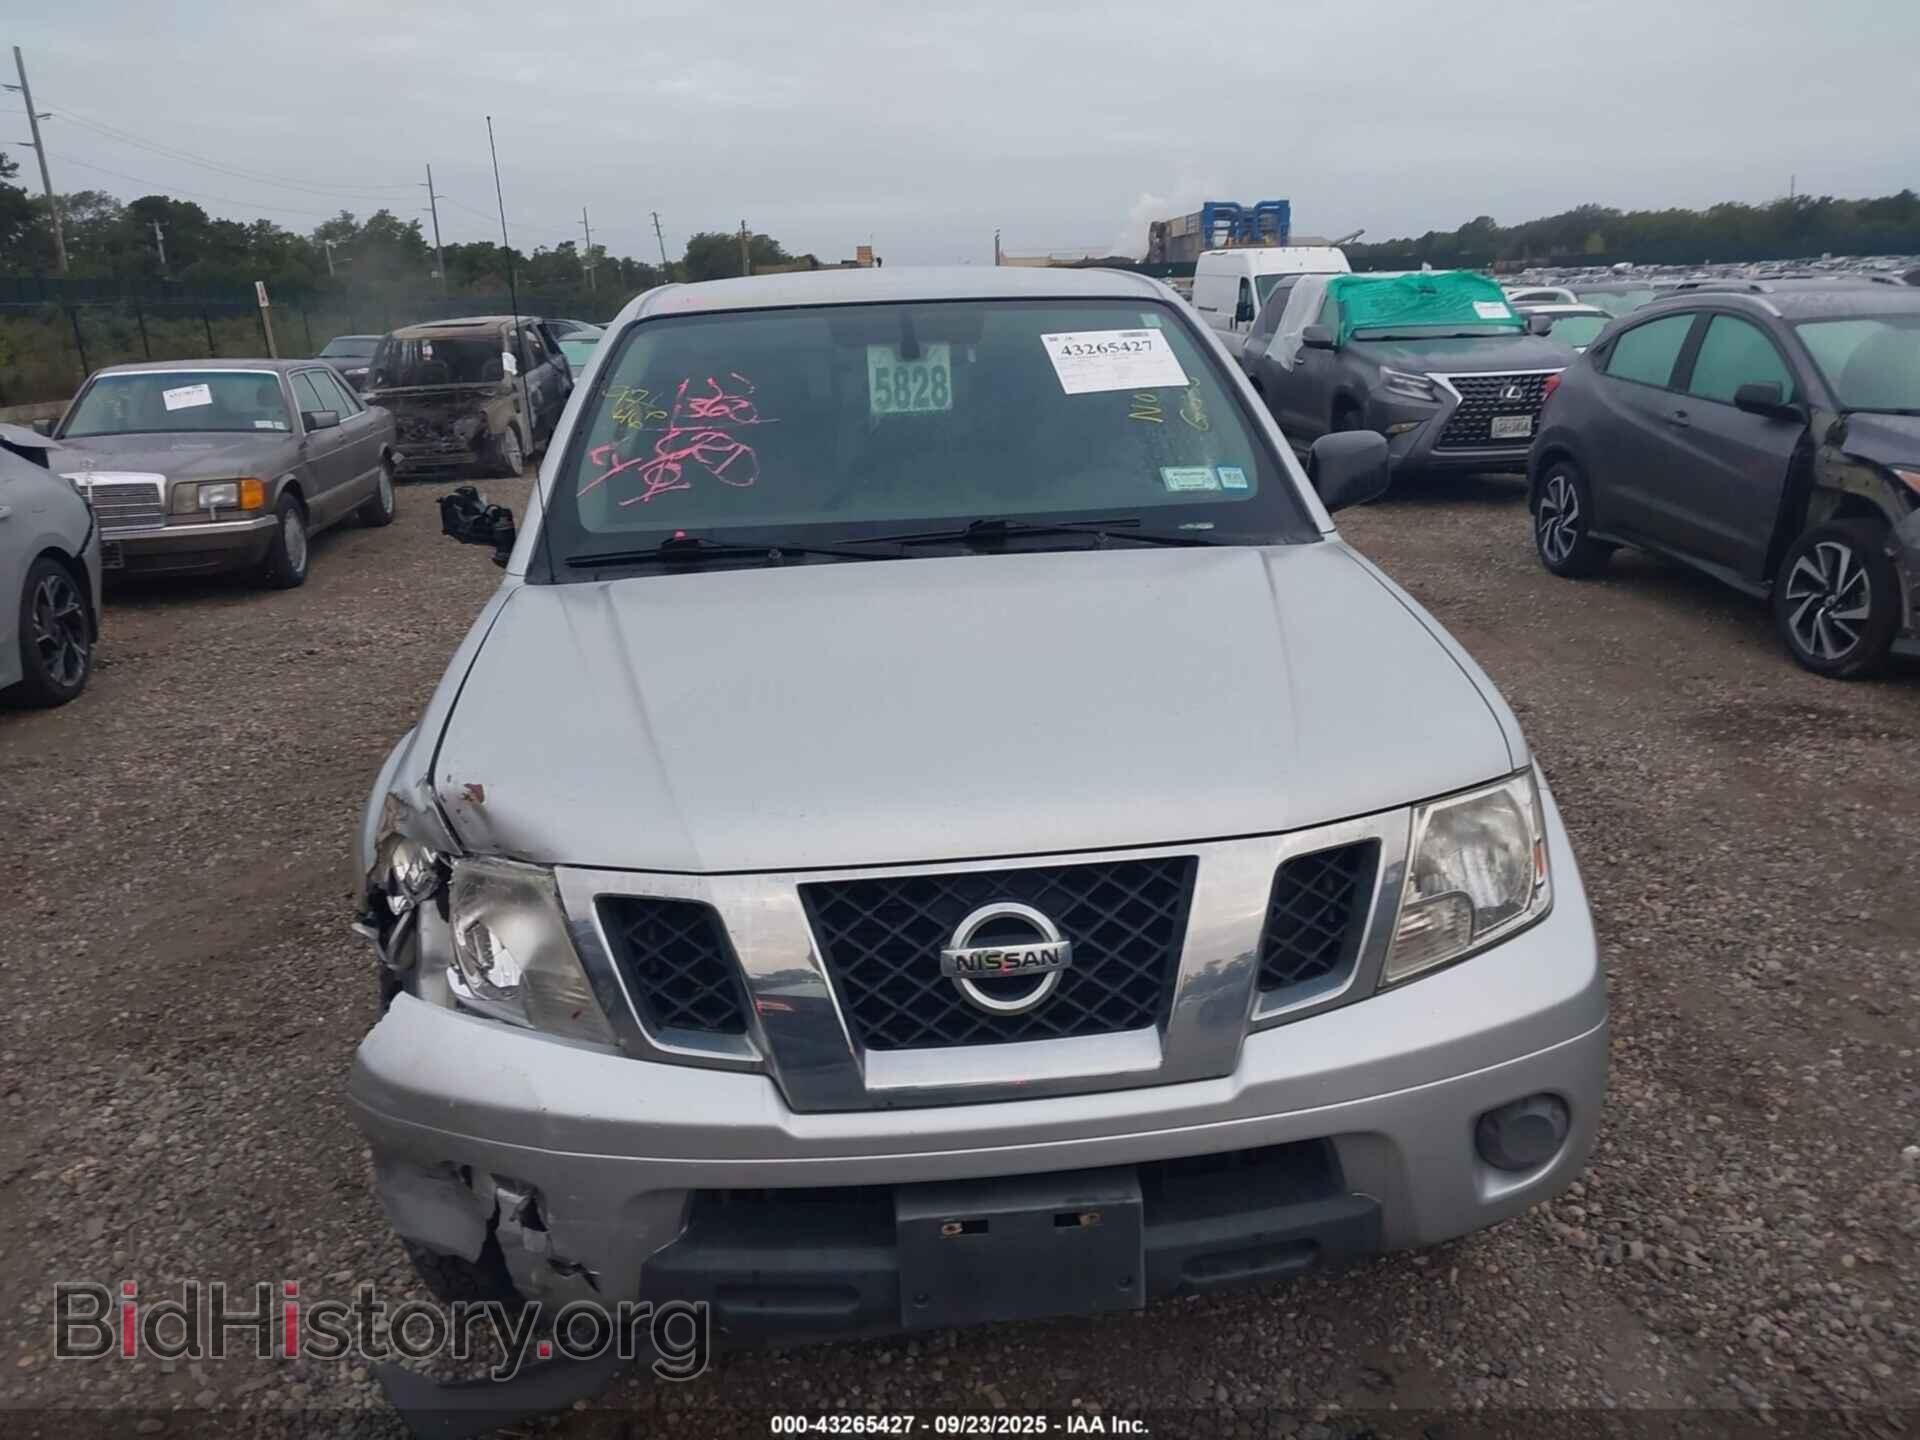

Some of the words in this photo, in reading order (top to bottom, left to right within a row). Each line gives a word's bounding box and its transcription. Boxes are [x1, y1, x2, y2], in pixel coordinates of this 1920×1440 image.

[1060, 339, 1153, 357] 43265427
[874, 365, 950, 409] 5828
[955, 948, 1060, 971] NISSAN
